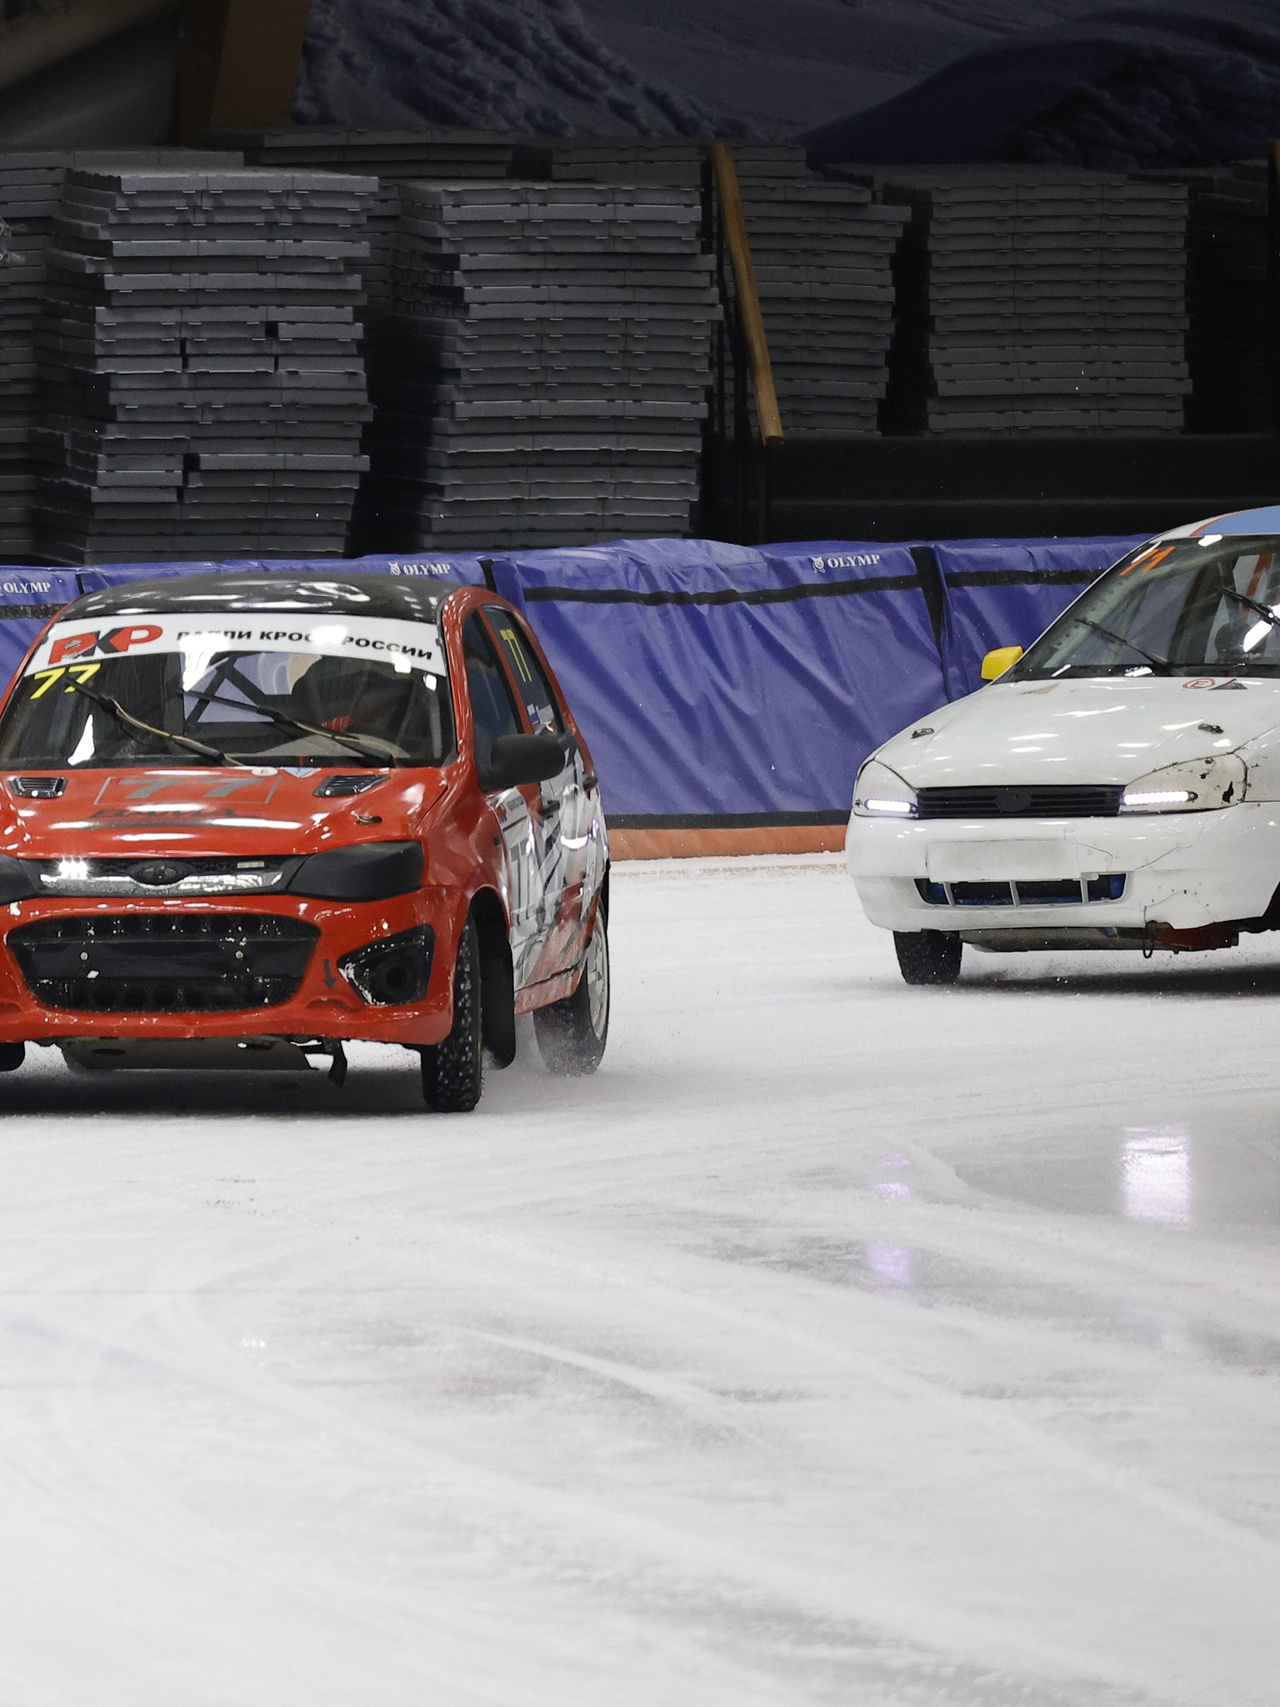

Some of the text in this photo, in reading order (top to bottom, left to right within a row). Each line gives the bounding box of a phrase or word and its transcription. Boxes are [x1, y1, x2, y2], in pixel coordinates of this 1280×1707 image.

[403, 563, 451, 575] OLYMP
[827, 554, 880, 568] OLYMP
[3, 582, 51, 593] OLYMP
[342, 636, 433, 660] РОССИИ
[30, 663, 101, 700] 77
[119, 778, 263, 799] 77
